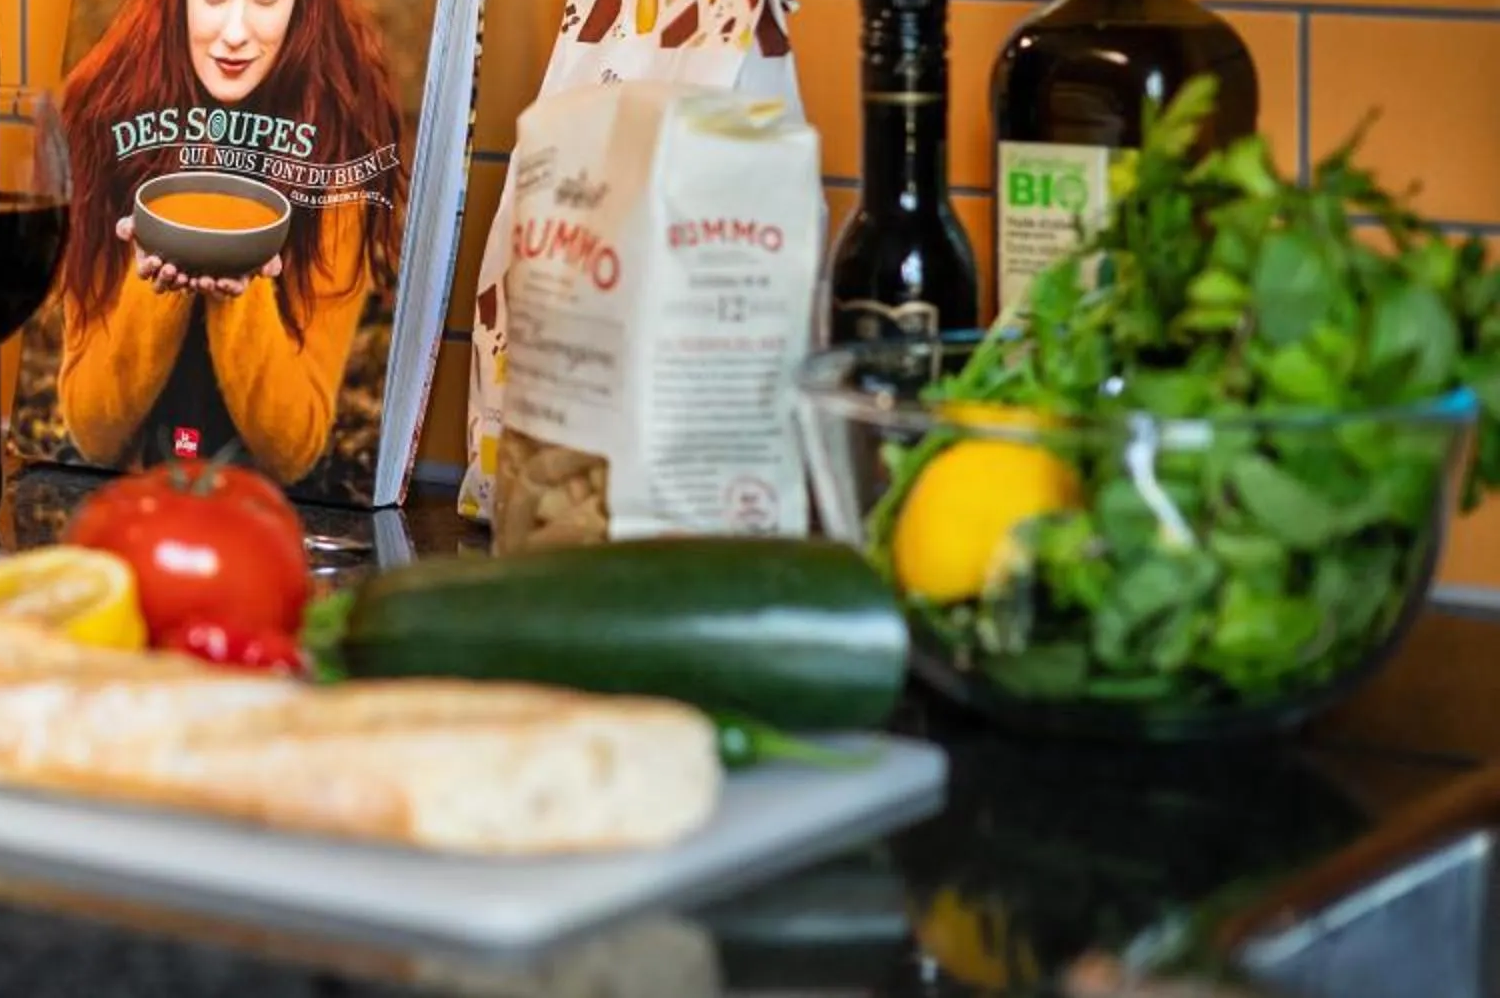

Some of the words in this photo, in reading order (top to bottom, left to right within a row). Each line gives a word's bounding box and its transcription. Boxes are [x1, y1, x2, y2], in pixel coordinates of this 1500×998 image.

[111, 107, 179, 157] DES
[185, 107, 317, 158] SOUPES
[179, 146, 208, 165] QUI
[212, 149, 257, 171] NOUS
[261, 157, 306, 183] FONT
[308, 167, 332, 185] DU
[335, 154, 377, 185] BIEN
